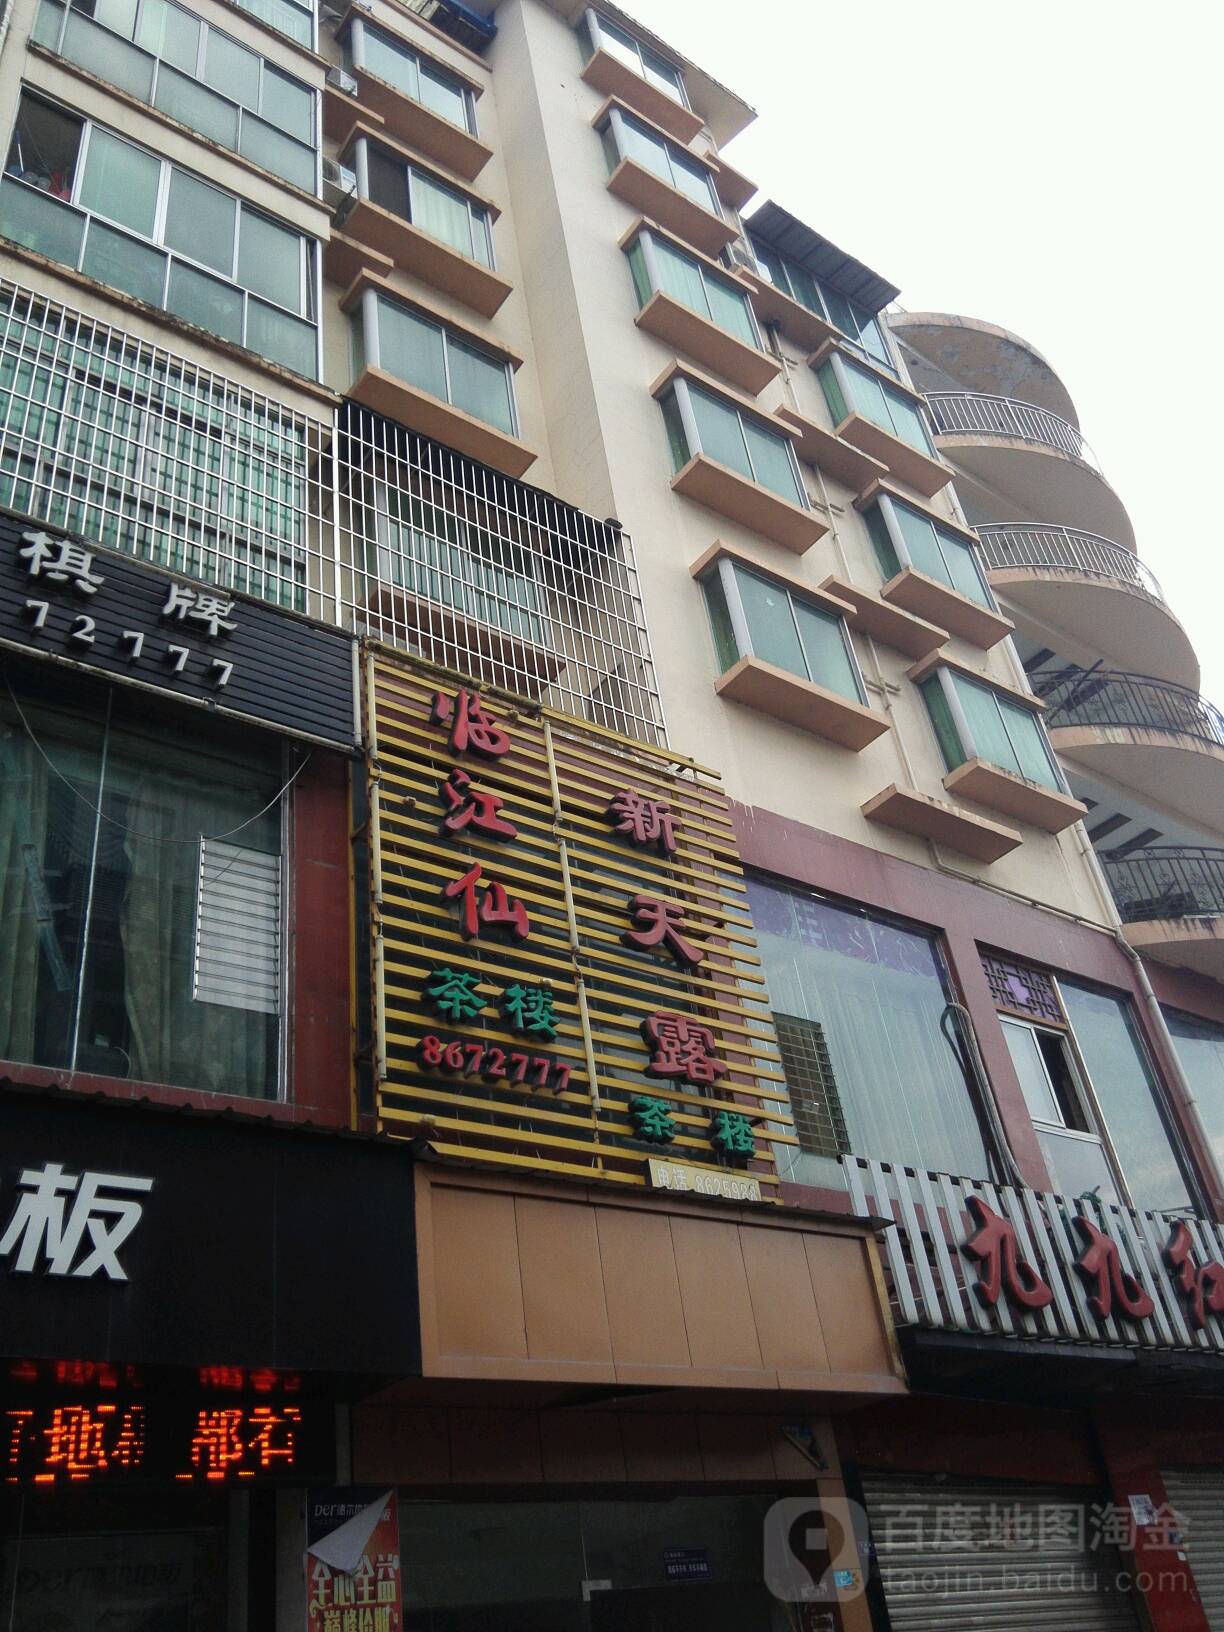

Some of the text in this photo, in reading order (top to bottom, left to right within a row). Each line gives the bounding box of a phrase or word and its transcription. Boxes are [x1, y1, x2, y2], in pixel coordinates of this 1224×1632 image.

[431, 688, 529, 940] 临江仙
[609, 787, 727, 1083] 新天露
[429, 967, 561, 1039] 茶楼
[421, 1035, 573, 1090] 8672777
[633, 1096, 756, 1156] 茶楼
[0, 1162, 154, 1281] 板
